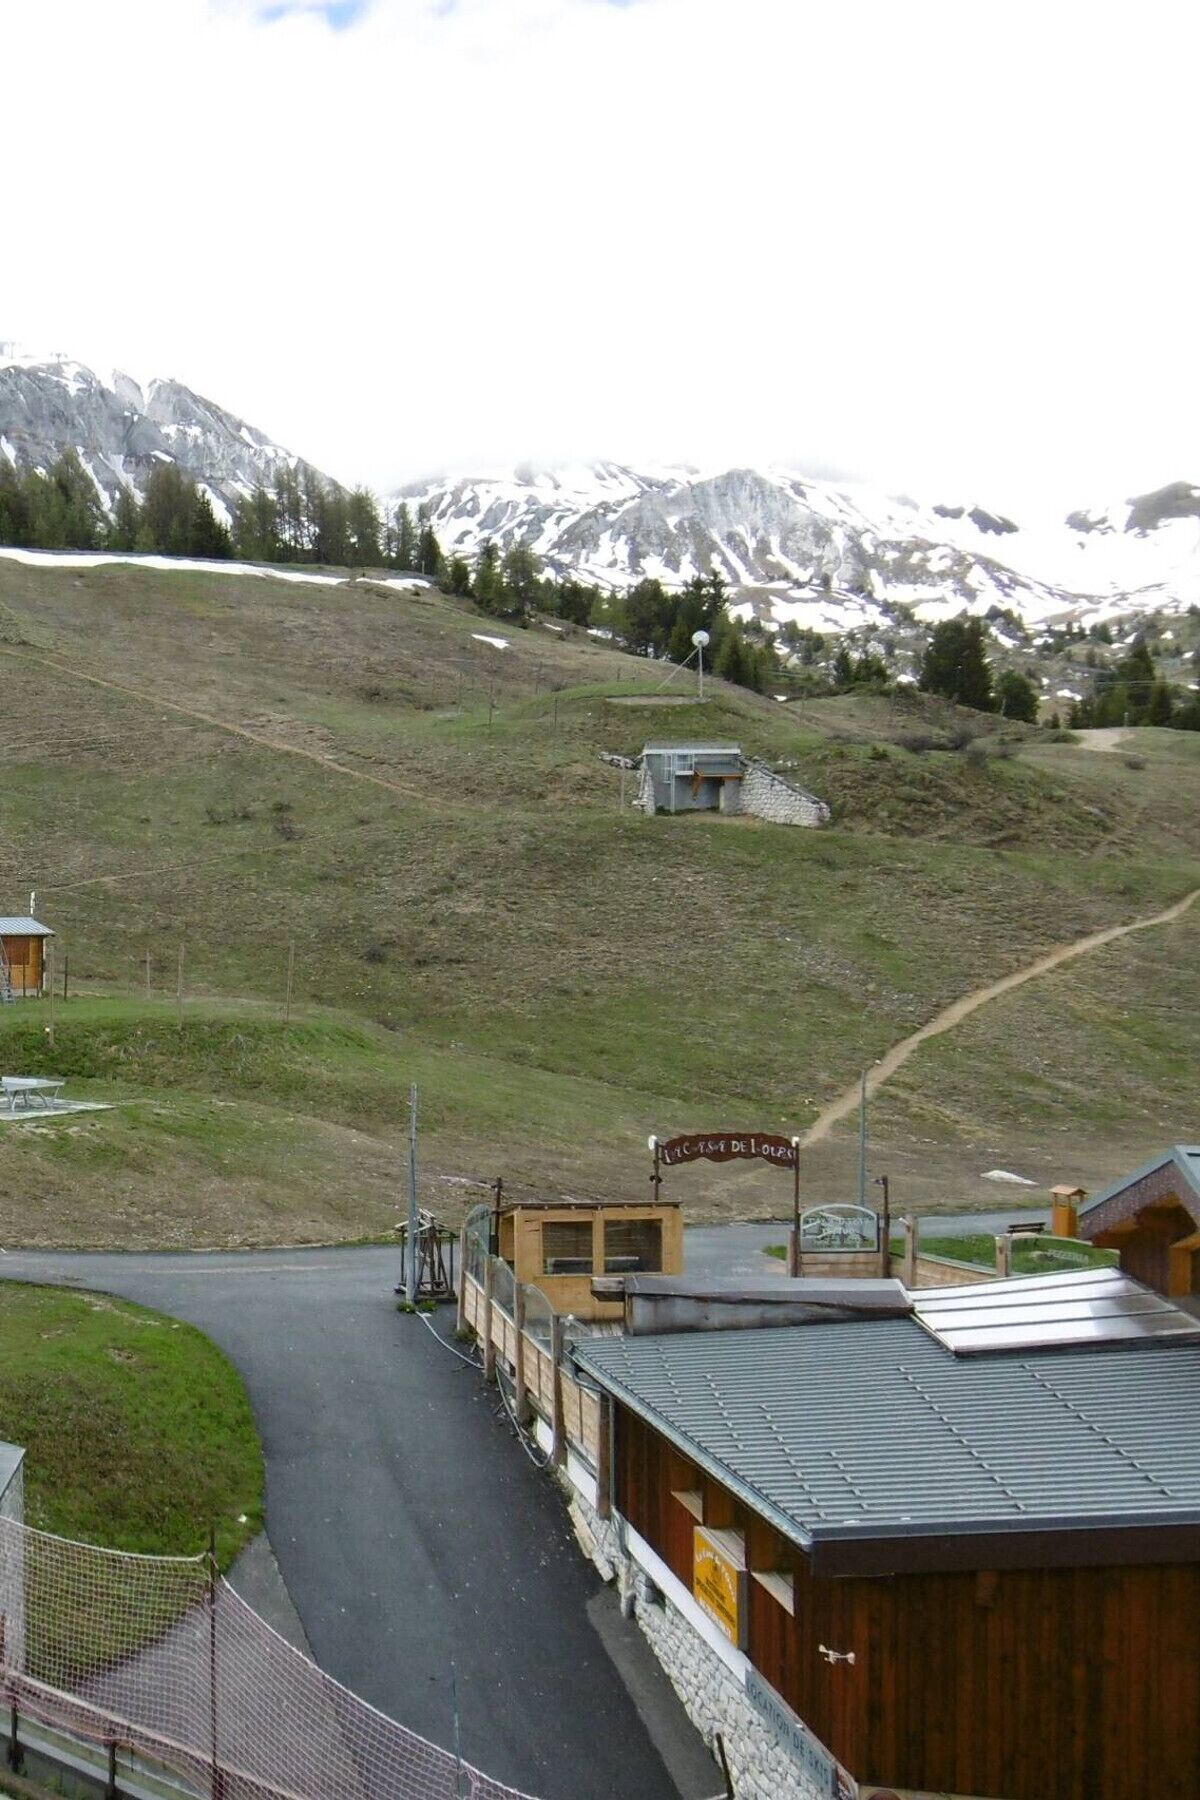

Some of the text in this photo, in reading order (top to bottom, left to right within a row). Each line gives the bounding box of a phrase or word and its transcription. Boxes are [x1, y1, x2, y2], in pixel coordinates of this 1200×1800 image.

[731, 1140, 748, 1153] DE
[746, 1677, 790, 1737] LOCATION
[792, 1732, 806, 1758] DE
